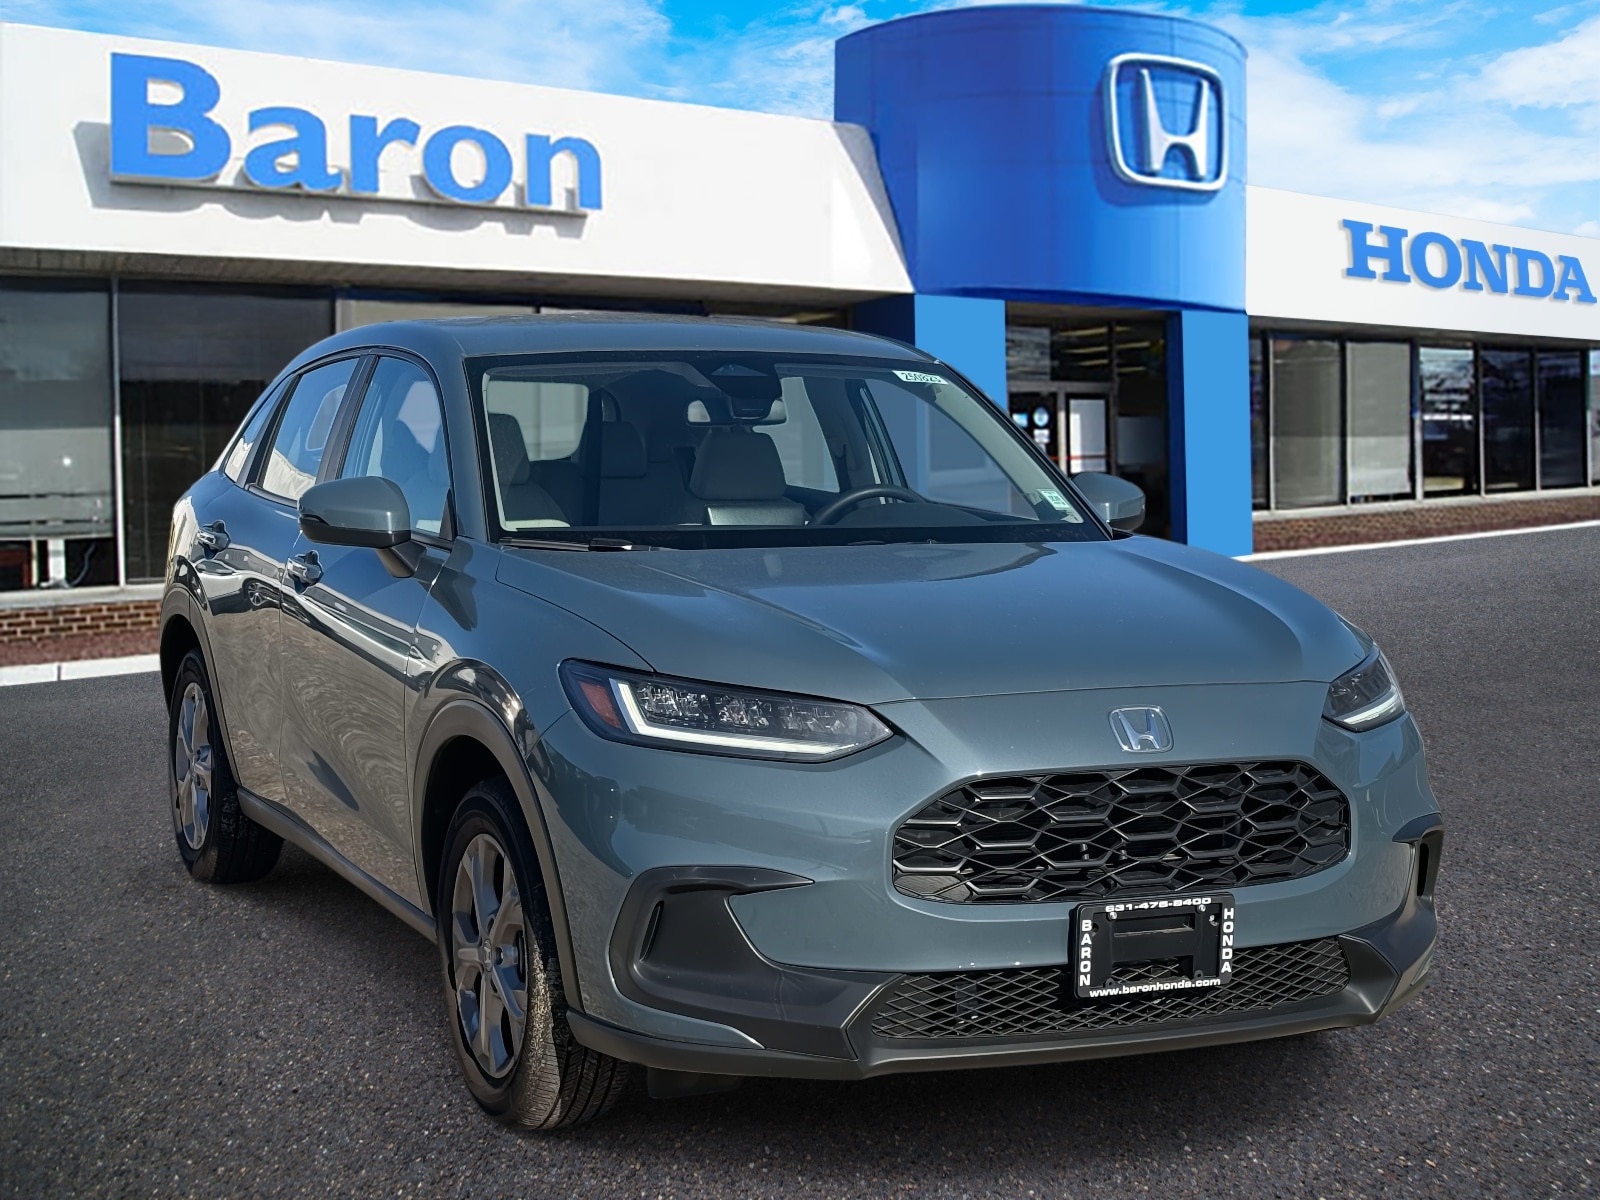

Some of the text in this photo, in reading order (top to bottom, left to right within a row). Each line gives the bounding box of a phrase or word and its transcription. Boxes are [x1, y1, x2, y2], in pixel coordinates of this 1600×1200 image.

[110, 52, 603, 211] Baron
[1342, 218, 1597, 303] HONDA
[1079, 919, 1092, 987] BARON
[1221, 907, 1235, 974] HONDA
[1089, 978, 1221, 998] www.baronhonda.com
